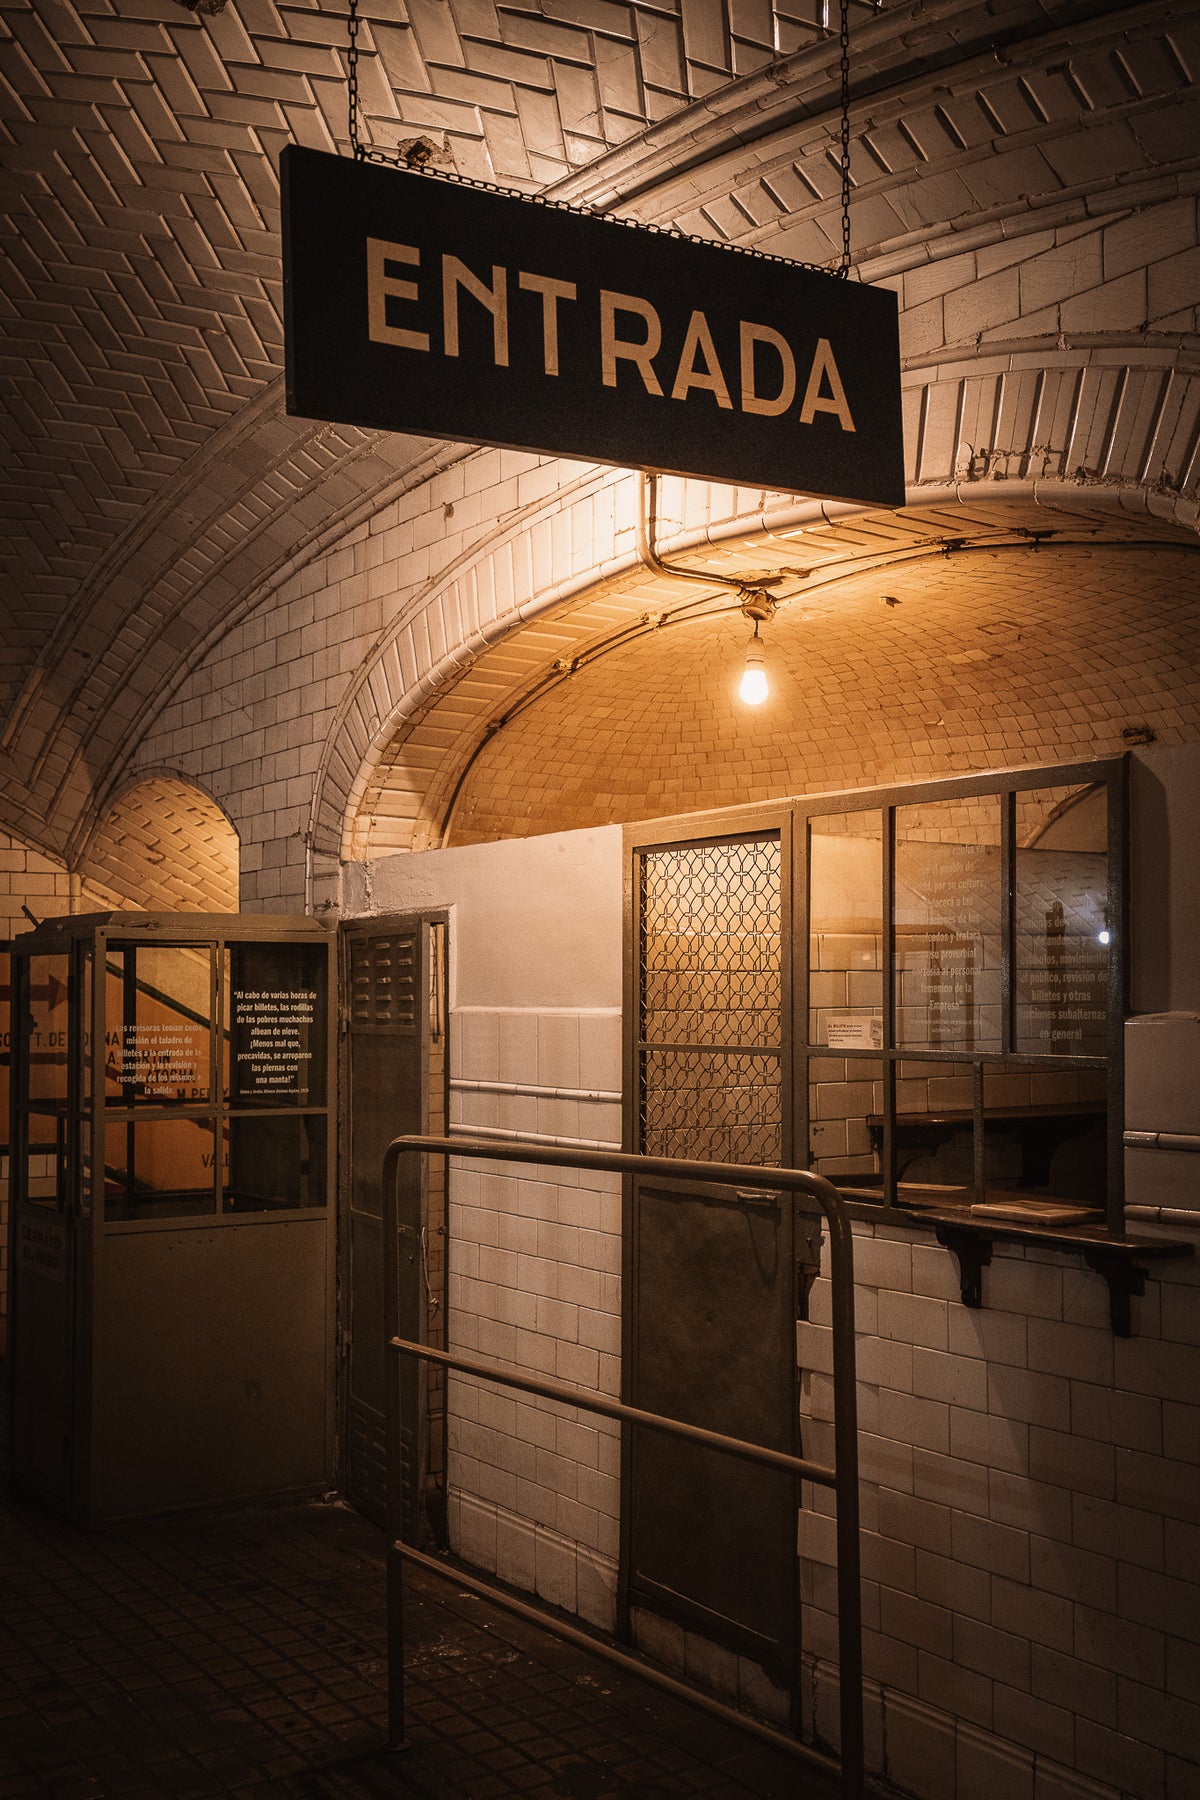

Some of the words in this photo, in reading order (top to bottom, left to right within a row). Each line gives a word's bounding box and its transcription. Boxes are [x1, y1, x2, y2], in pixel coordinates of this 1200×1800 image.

[366, 237, 857, 433] ENTRADA
[962, 895, 974, 906] las
[958, 913, 967, 924] de
[949, 933, 955, 943] y
[940, 947, 977, 960] proverbial
[941, 965, 949, 976] al
[950, 966, 982, 978] personal
[1063, 969, 1095, 982] revisión
[1097, 969, 1109, 981] de
[920, 984, 953, 993] femenino
[955, 983, 964, 993] de
[965, 982, 972, 993] la
[244, 991, 260, 999] cabo
[261, 991, 270, 999] de
[270, 991, 290, 999] varias
[290, 991, 308, 1000] horas
[308, 991, 318, 1000] de
[1031, 990, 1061, 1000] billetes
[1062, 990, 1068, 1001] y
[1068, 990, 1092, 1000] otras
[236, 1004, 253, 1013] picar
[1058, 1009, 1107, 1019] subalternas
[236, 1016, 245, 1024] de
[245, 1016, 256, 1024] las
[256, 1016, 278, 1025] pobres
[278, 1016, 314, 1024] muchachas
[129, 1024, 160, 1032] revisoras
[250, 1028, 272, 1036] albean
[272, 1028, 281, 1036] de
[281, 1028, 300, 1036] nieve.
[1039, 1029, 1049, 1039] en
[1051, 1029, 1082, 1041] general
[126, 1036, 149, 1045] misión
[150, 1036, 158, 1044] el
[158, 1036, 183, 1044] taladro
[184, 1036, 193, 1044] de
[250, 1040, 274, 1049] ¡Menos
[274, 1040, 287, 1048] mal
[157, 1048, 184, 1057] entrada
[185, 1048, 194, 1057] de
[237, 1052, 273, 1062] precavidas,
[282, 1053, 313, 1061] arroparon
[121, 1061, 150, 1070] estación
[151, 1063, 156, 1071] y
[157, 1061, 164, 1069] la
[165, 1060, 192, 1070] revisión
[251, 1064, 261, 1072] las
[262, 1064, 286, 1073] piernas
[116, 1075, 147, 1084] recogida
[158, 1074, 168, 1082] los
[144, 1086, 151, 1095] la
